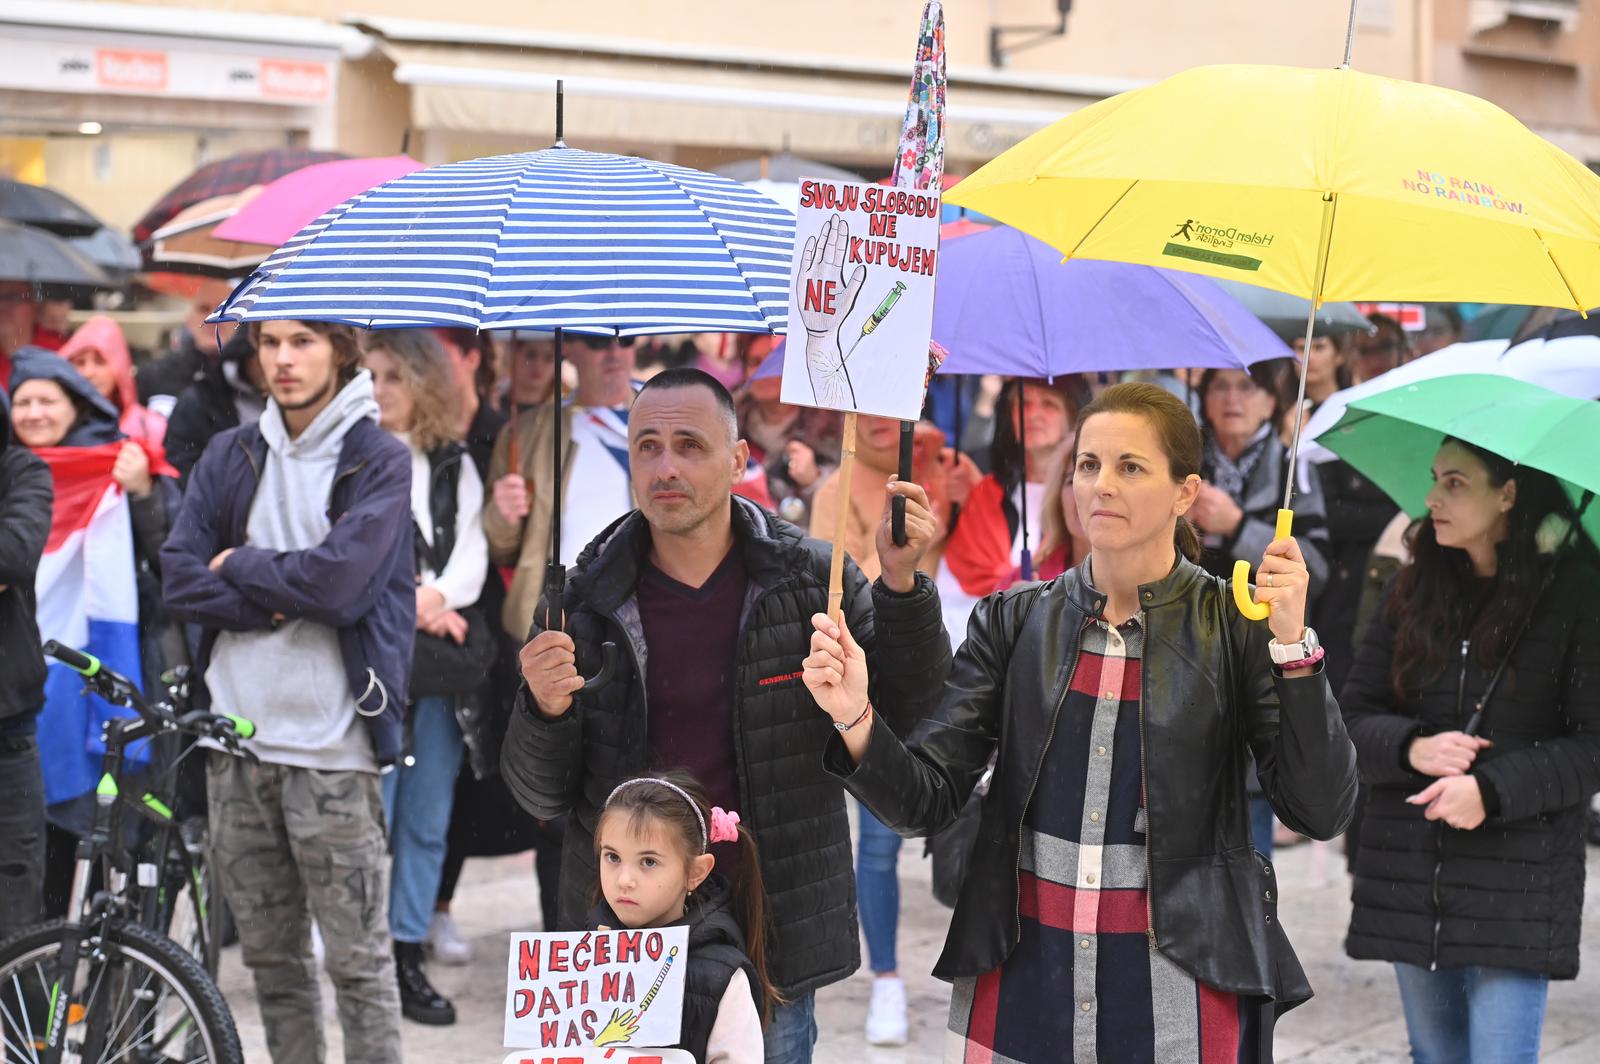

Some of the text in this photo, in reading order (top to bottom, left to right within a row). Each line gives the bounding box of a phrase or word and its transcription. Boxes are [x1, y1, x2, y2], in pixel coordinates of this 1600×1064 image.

[1402, 179, 1430, 194] NO
[1417, 170, 1445, 185] NO
[800, 181, 938, 218] SVOJU SLOBODU
[869, 213, 897, 238] NE
[849, 236, 935, 276] KUPUJEM
[804, 278, 836, 315] NE
[519, 931, 664, 980] NEĆEMO
[514, 971, 635, 1018] DATI NA
[541, 1009, 598, 1048] NAS
